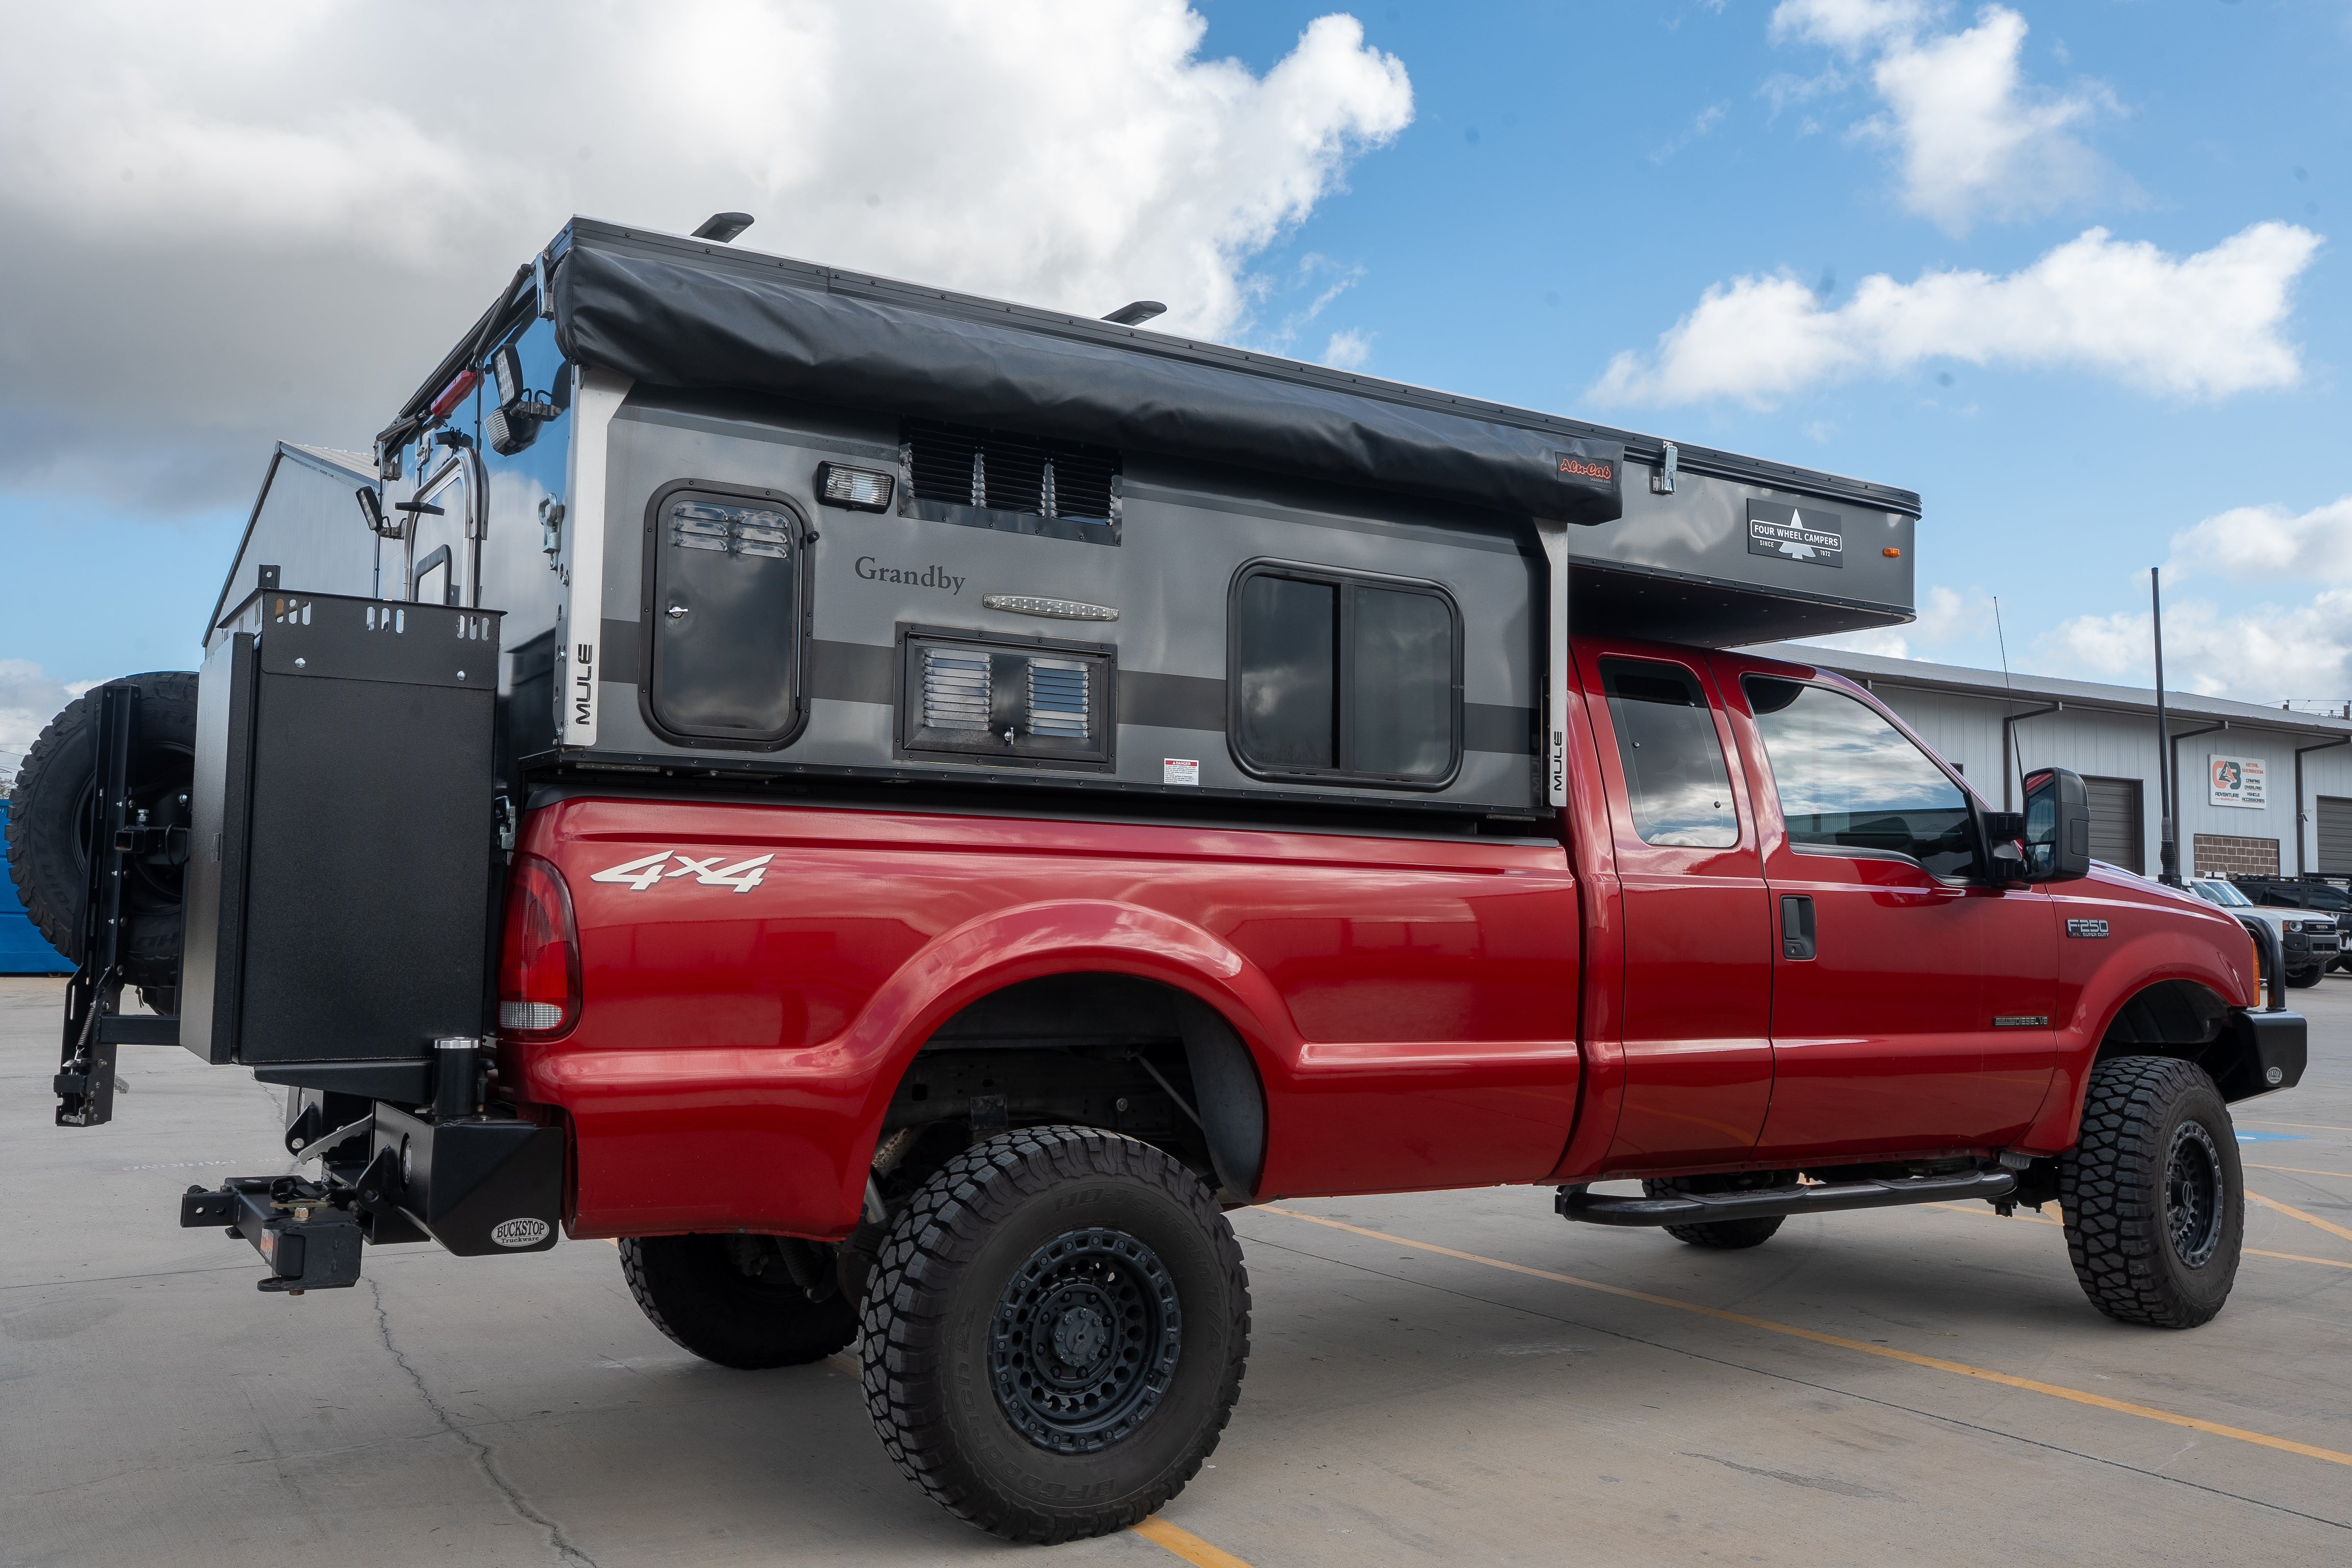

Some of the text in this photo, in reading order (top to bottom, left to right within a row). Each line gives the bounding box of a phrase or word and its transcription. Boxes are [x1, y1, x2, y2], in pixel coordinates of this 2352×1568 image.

[1560, 459, 1611, 479] Alu-Cab
[1754, 524, 1838, 547] FOUR WHEEL CAMPERS
[854, 556, 966, 596] Grandby
[576, 644, 593, 725] MULE
[1554, 731, 1562, 791] MULE
[496, 1220, 545, 1238] BUCKSTOP
[955, 1361, 1116, 1502] BFGoodrich
